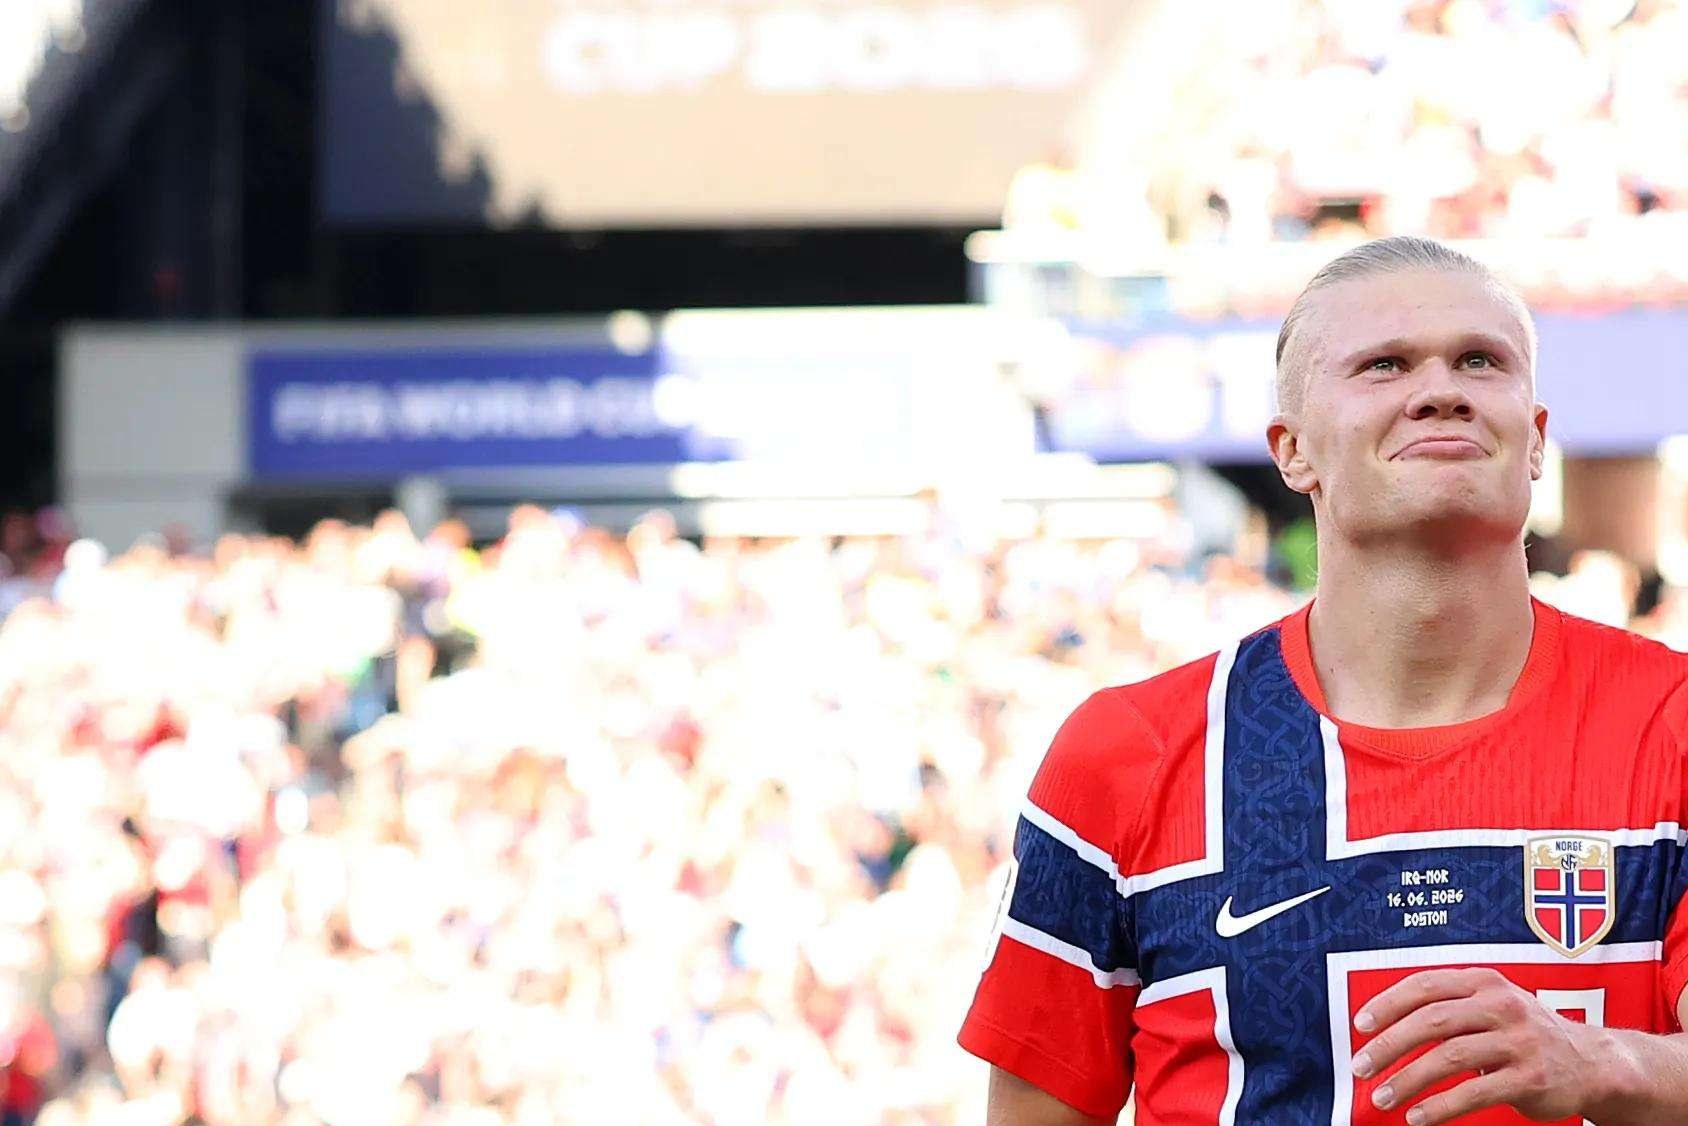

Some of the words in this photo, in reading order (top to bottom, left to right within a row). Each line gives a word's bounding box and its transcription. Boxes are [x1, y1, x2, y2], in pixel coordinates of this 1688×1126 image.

[1555, 840, 1582, 852] NORGE
[1401, 869, 1448, 886] IRQ-NOR
[1403, 910, 1448, 927] BOSTON
